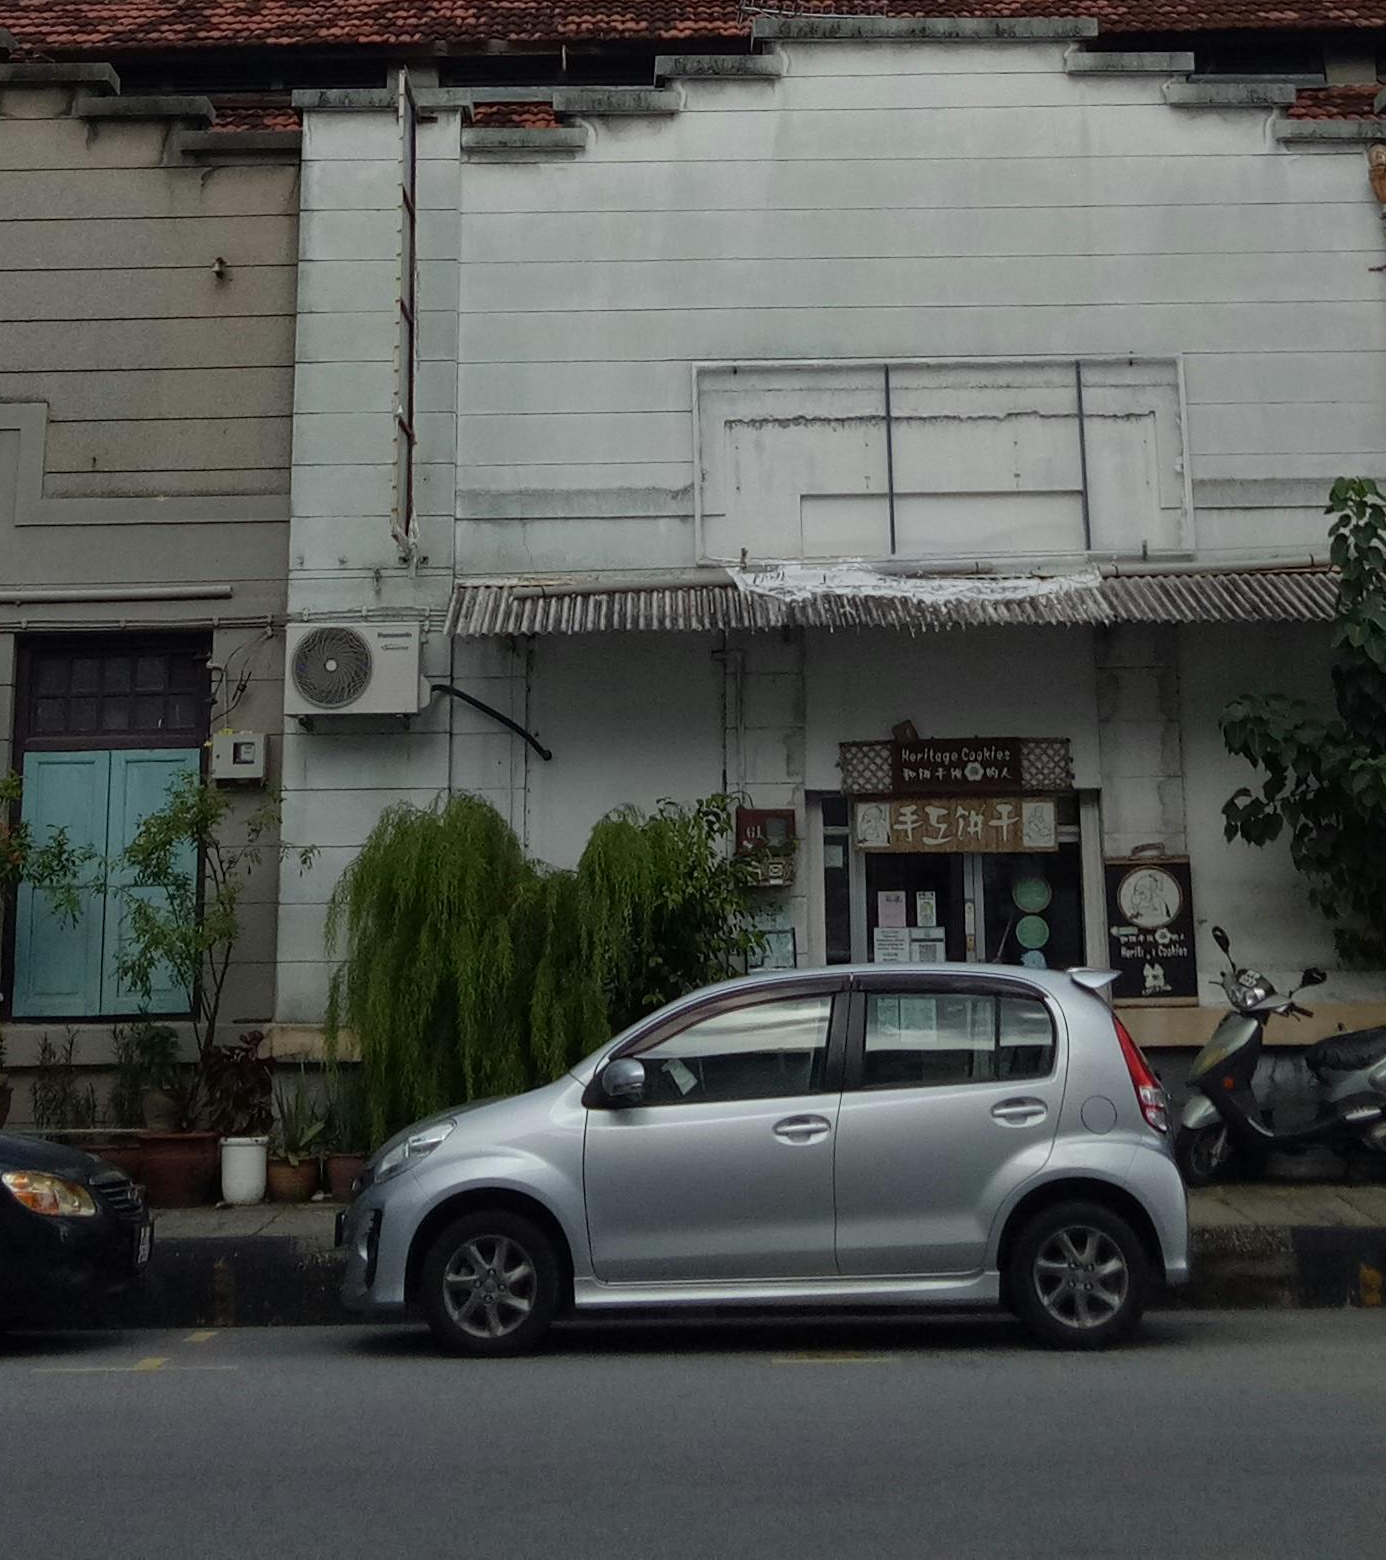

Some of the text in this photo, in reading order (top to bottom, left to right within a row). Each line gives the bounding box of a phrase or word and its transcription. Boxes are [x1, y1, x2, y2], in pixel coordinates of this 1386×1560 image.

[901, 744, 1011, 765] Heritage Cookies
[893, 803, 1020, 846] 手工饼干
